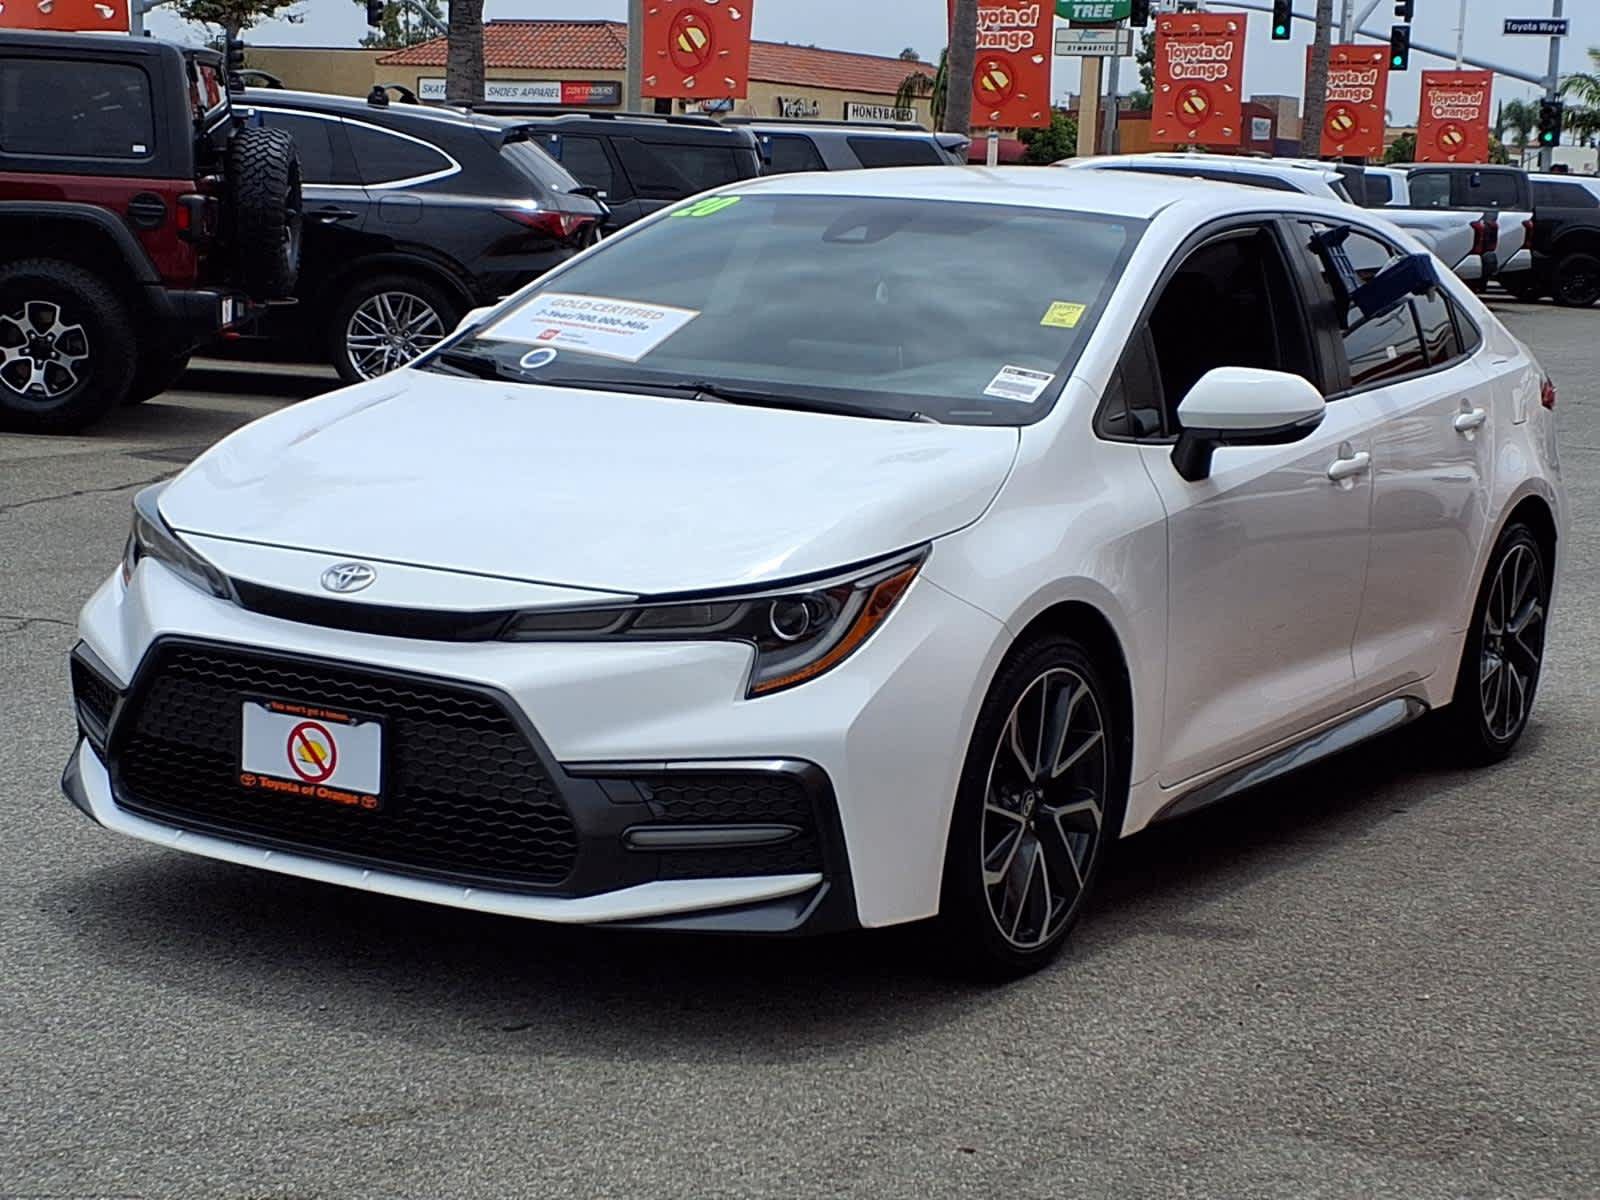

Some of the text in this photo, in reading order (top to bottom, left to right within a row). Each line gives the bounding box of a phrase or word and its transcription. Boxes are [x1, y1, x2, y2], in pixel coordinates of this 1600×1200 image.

[976, 5, 1038, 30] yota of
[1072, 4, 1114, 18] TREE
[1506, 22, 1560, 32] Toyota Way
[1166, 42, 1232, 62] Toyota of
[1171, 62, 1228, 81] Orange
[1328, 69, 1378, 87] yota of
[422, 84, 559, 98] SKAT SHOES APPAREL
[1429, 90, 1483, 107] Toyota of
[1432, 106, 1479, 121] Orange
[550, 298, 665, 320] GOLD CERTIFIED
[258, 775, 360, 805] Toyota of Orange
